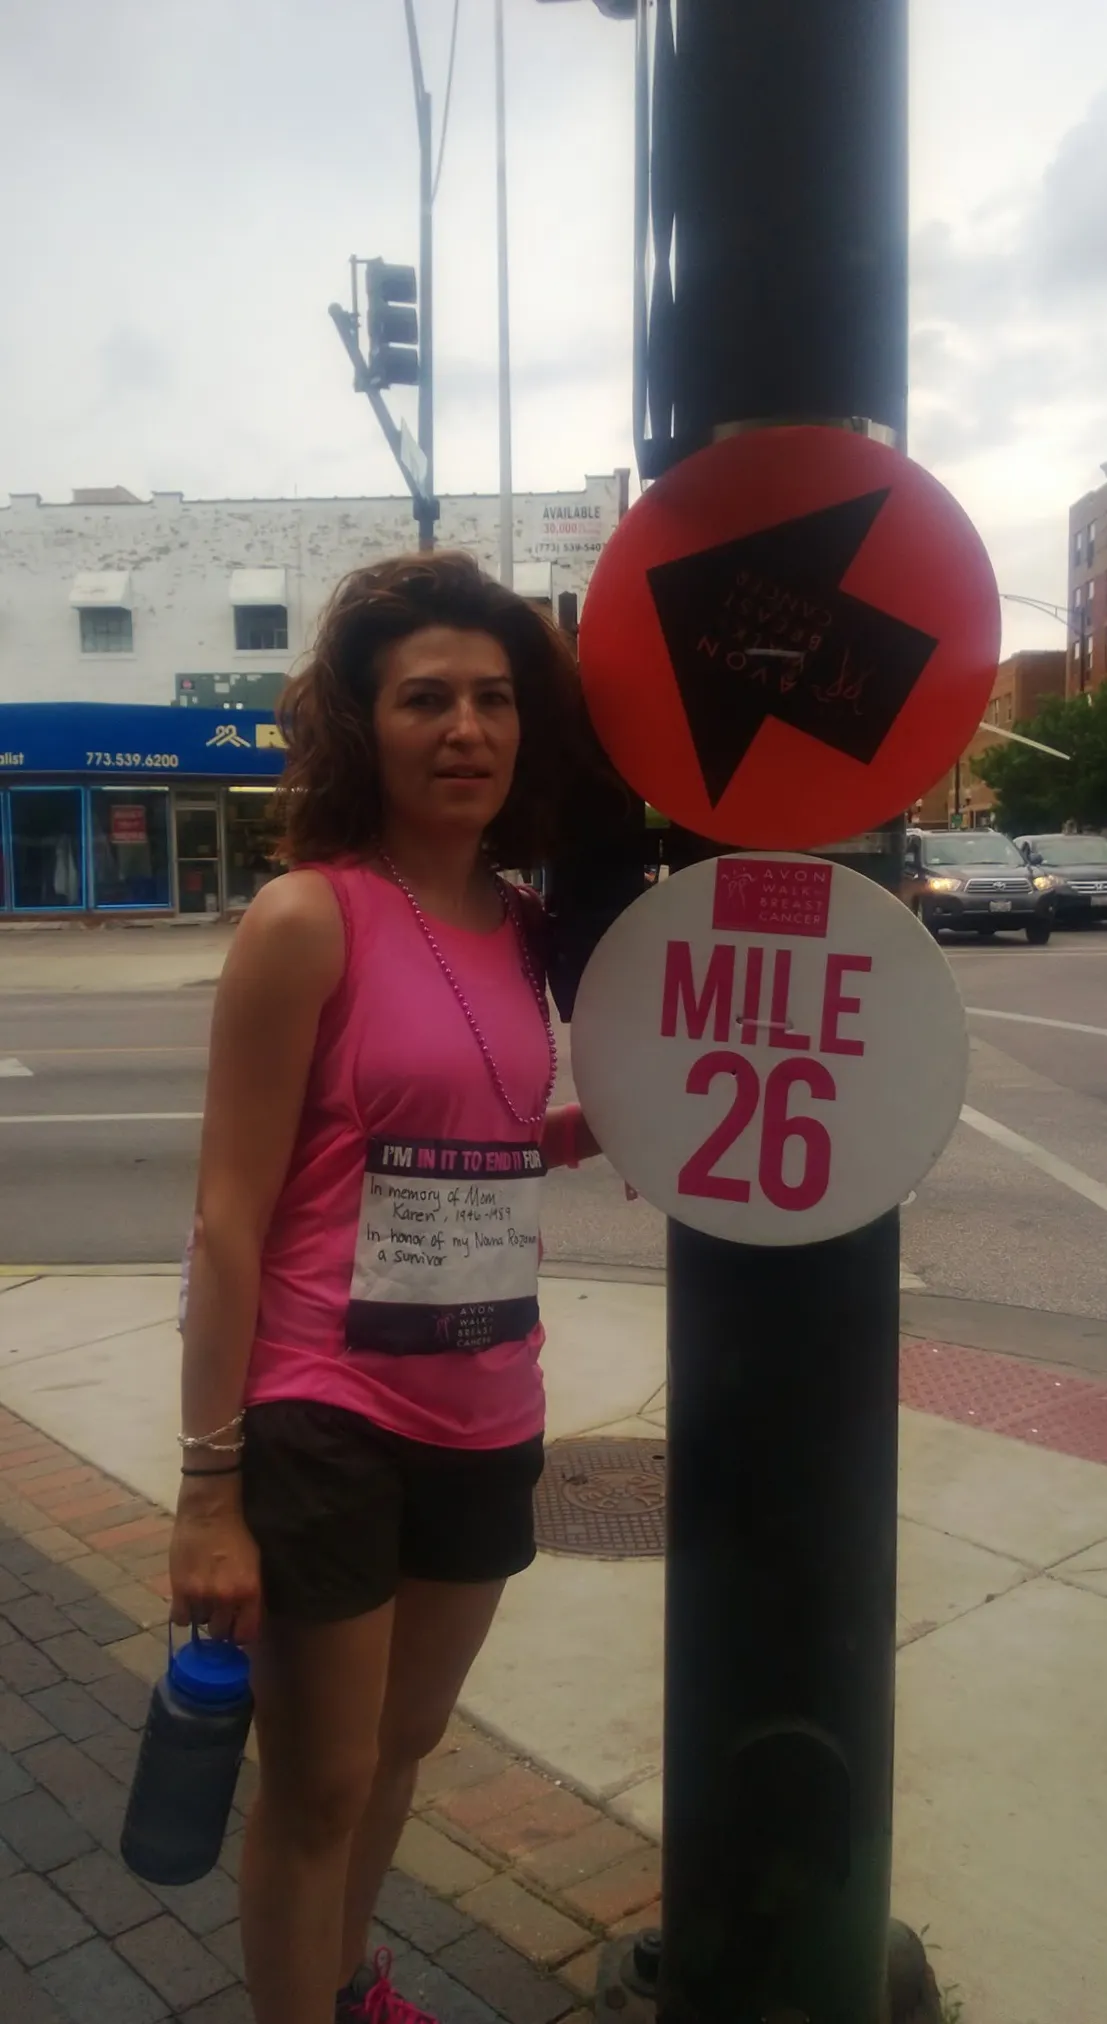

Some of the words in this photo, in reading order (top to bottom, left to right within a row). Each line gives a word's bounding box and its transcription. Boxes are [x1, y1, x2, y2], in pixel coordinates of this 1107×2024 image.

[543, 506, 601, 519] AVAILABLE
[697, 635, 797, 693] AVON
[86, 752, 179, 768] 773.539.6200
[763, 868, 826, 882] AVON
[760, 897, 823, 912] BREAST
[759, 912, 821, 925] CANCER
[660, 940, 872, 1057] MILE
[677, 1050, 836, 1212] 26
[382, 1144, 413, 1168] I'M
[416, 1148, 436, 1170] IN
[440, 1150, 457, 1171] IT
[462, 1150, 481, 1172] TO
[485, 1151, 511, 1172] END
[522, 1149, 542, 1169] FOR
[370, 1176, 383, 1195] In
[389, 1188, 440, 1211] memory
[447, 1187, 460, 1206] of
[367, 1223, 380, 1242] In
[390, 1228, 426, 1245] honor
[430, 1232, 445, 1249] of
[452, 1237, 470, 1258] my
[378, 1250, 387, 1262] a
[460, 1305, 494, 1315] AVON
